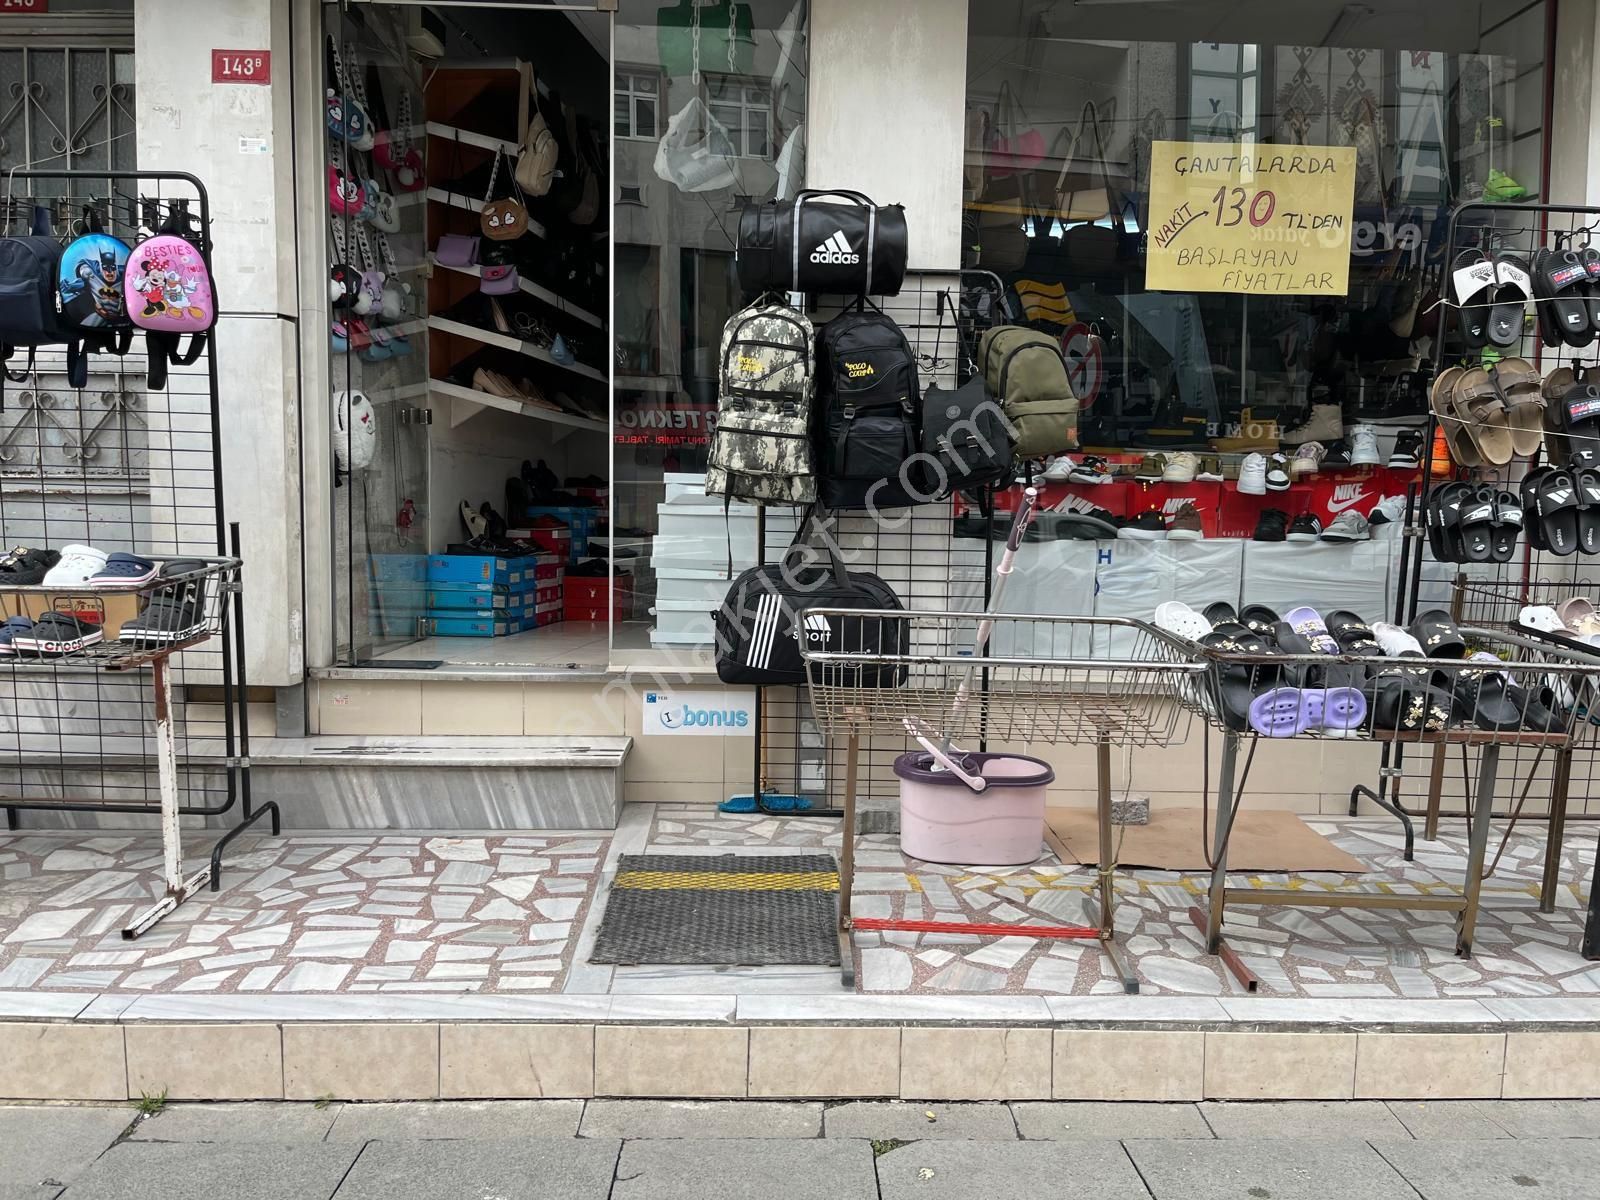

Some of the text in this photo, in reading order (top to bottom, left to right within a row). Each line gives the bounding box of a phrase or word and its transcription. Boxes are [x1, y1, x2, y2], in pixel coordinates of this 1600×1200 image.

[1174, 156, 1336, 176] ÇANTALARDA
[1212, 186, 1276, 227] 130
[144, 244, 192, 257] BESTIES
[810, 250, 860, 264] adidas
[1177, 247, 1298, 268] BAŞLAYAN
[1333, 483, 1364, 501] NIKE
[44, 639, 82, 651] crocs
[793, 630, 832, 643] sort
[683, 704, 749, 727] bonus
